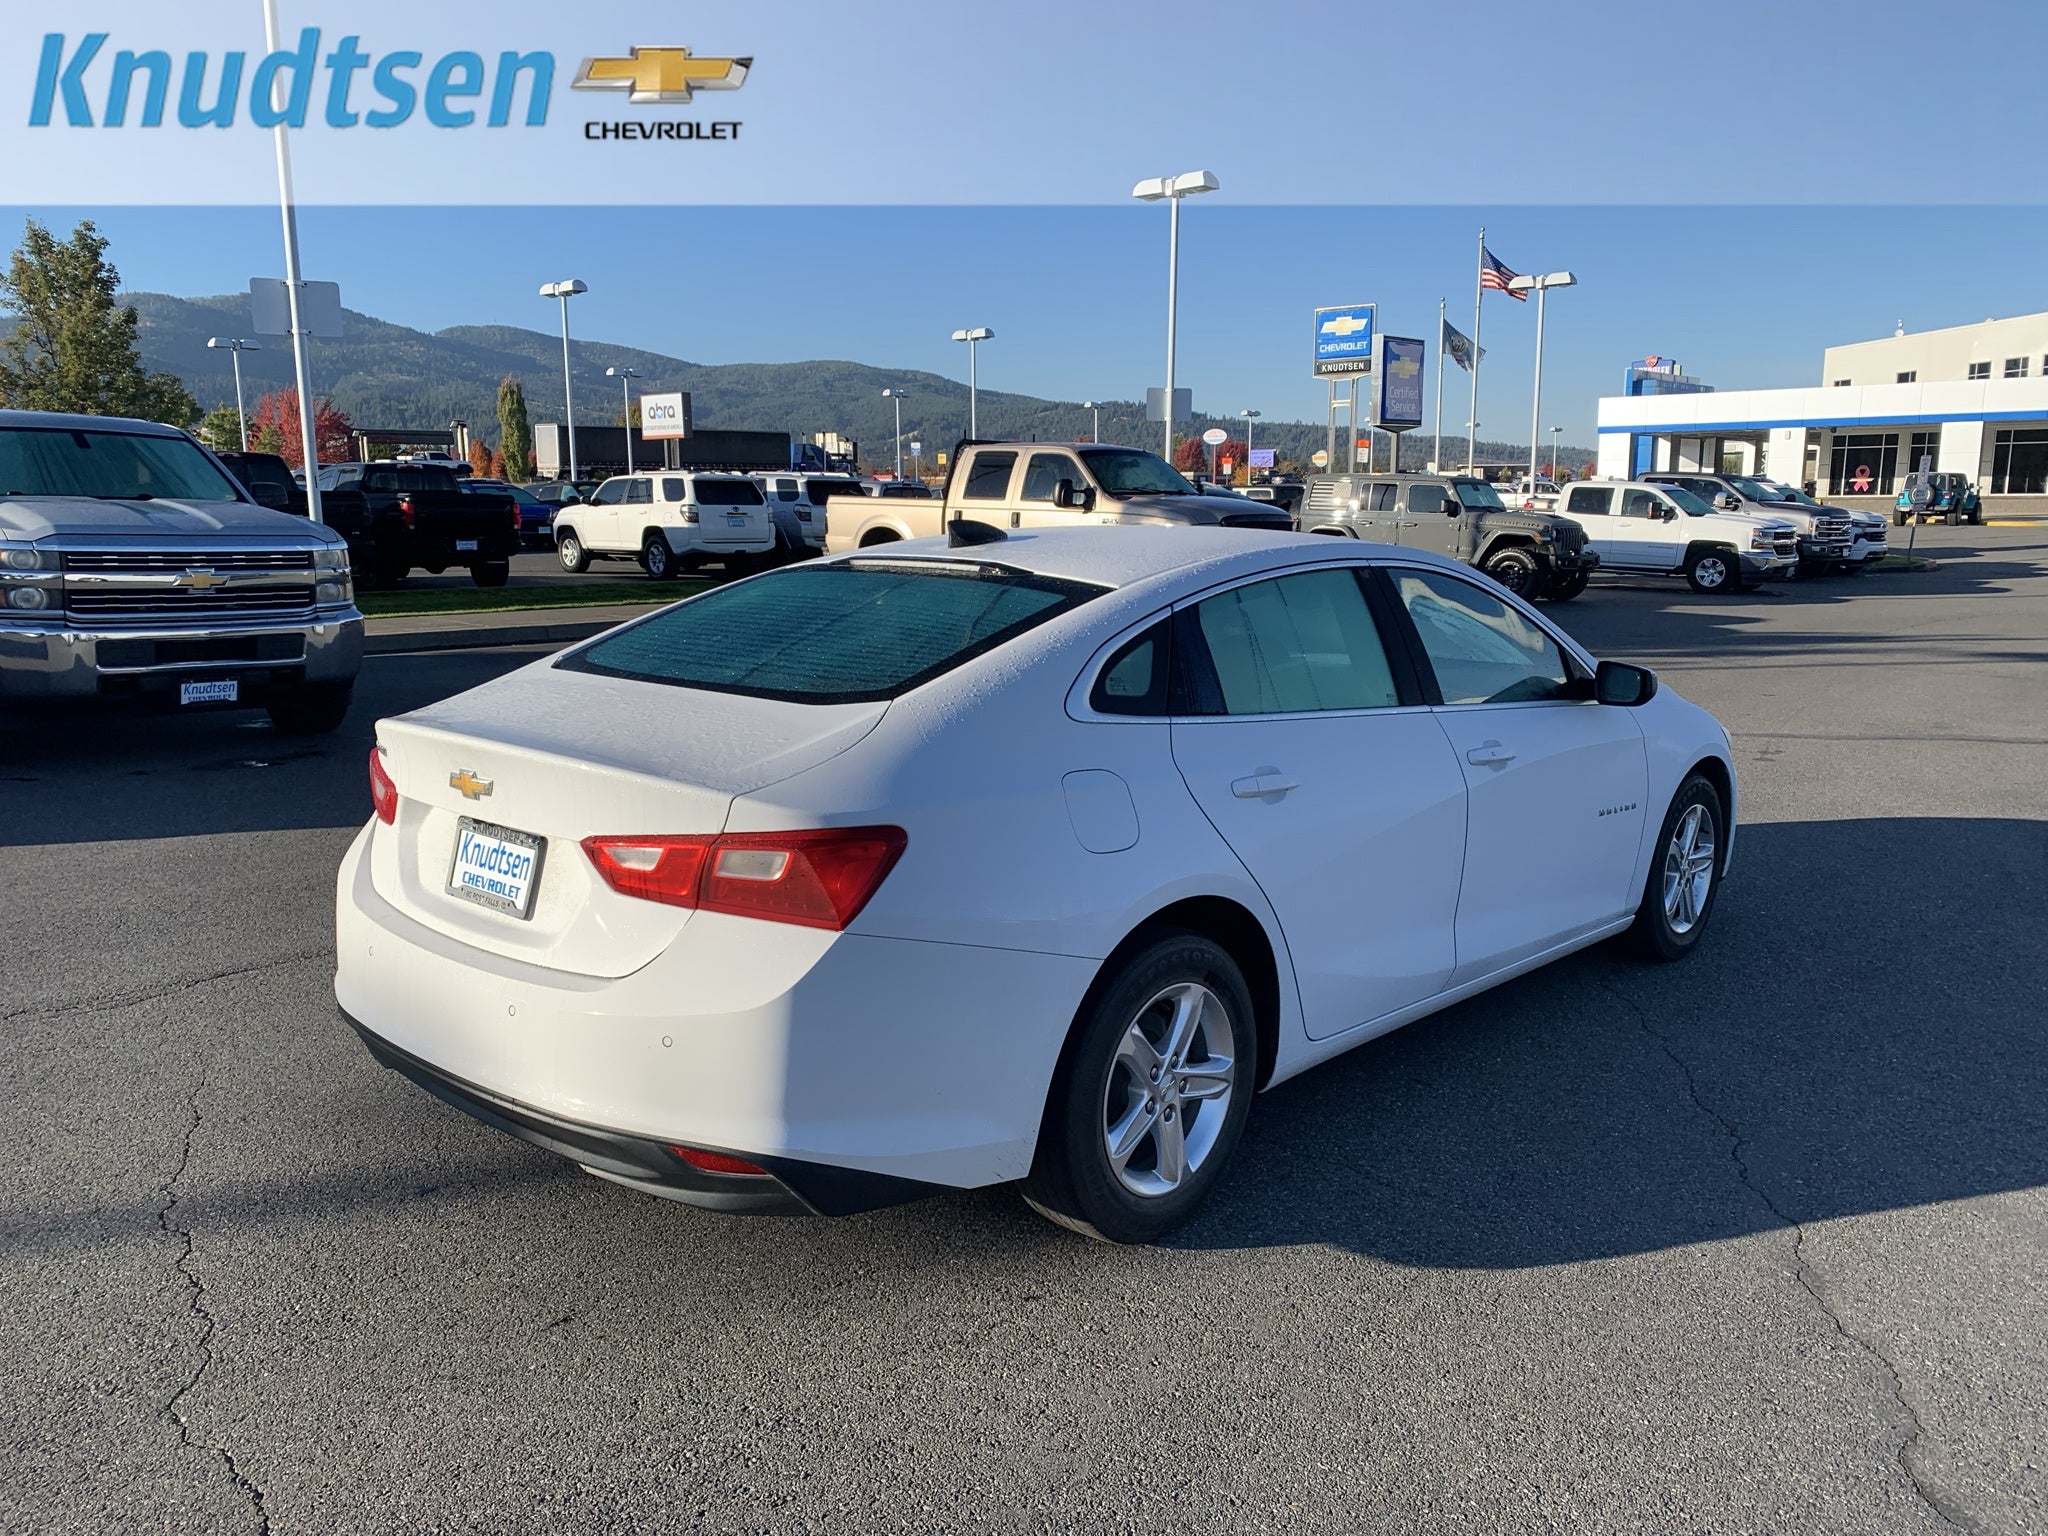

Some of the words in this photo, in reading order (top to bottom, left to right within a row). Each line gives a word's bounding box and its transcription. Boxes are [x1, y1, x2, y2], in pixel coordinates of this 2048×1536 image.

[1319, 341, 1368, 353] CHEVROLET
[1321, 362, 1365, 373] KNUDTSEN
[1390, 386, 1419, 399] Certified
[648, 403, 676, 420] abra
[1391, 400, 1416, 413] Service
[184, 682, 236, 695] Knudtsen
[460, 832, 531, 881] Knudtsen
[462, 871, 521, 900] CHEVROLET
